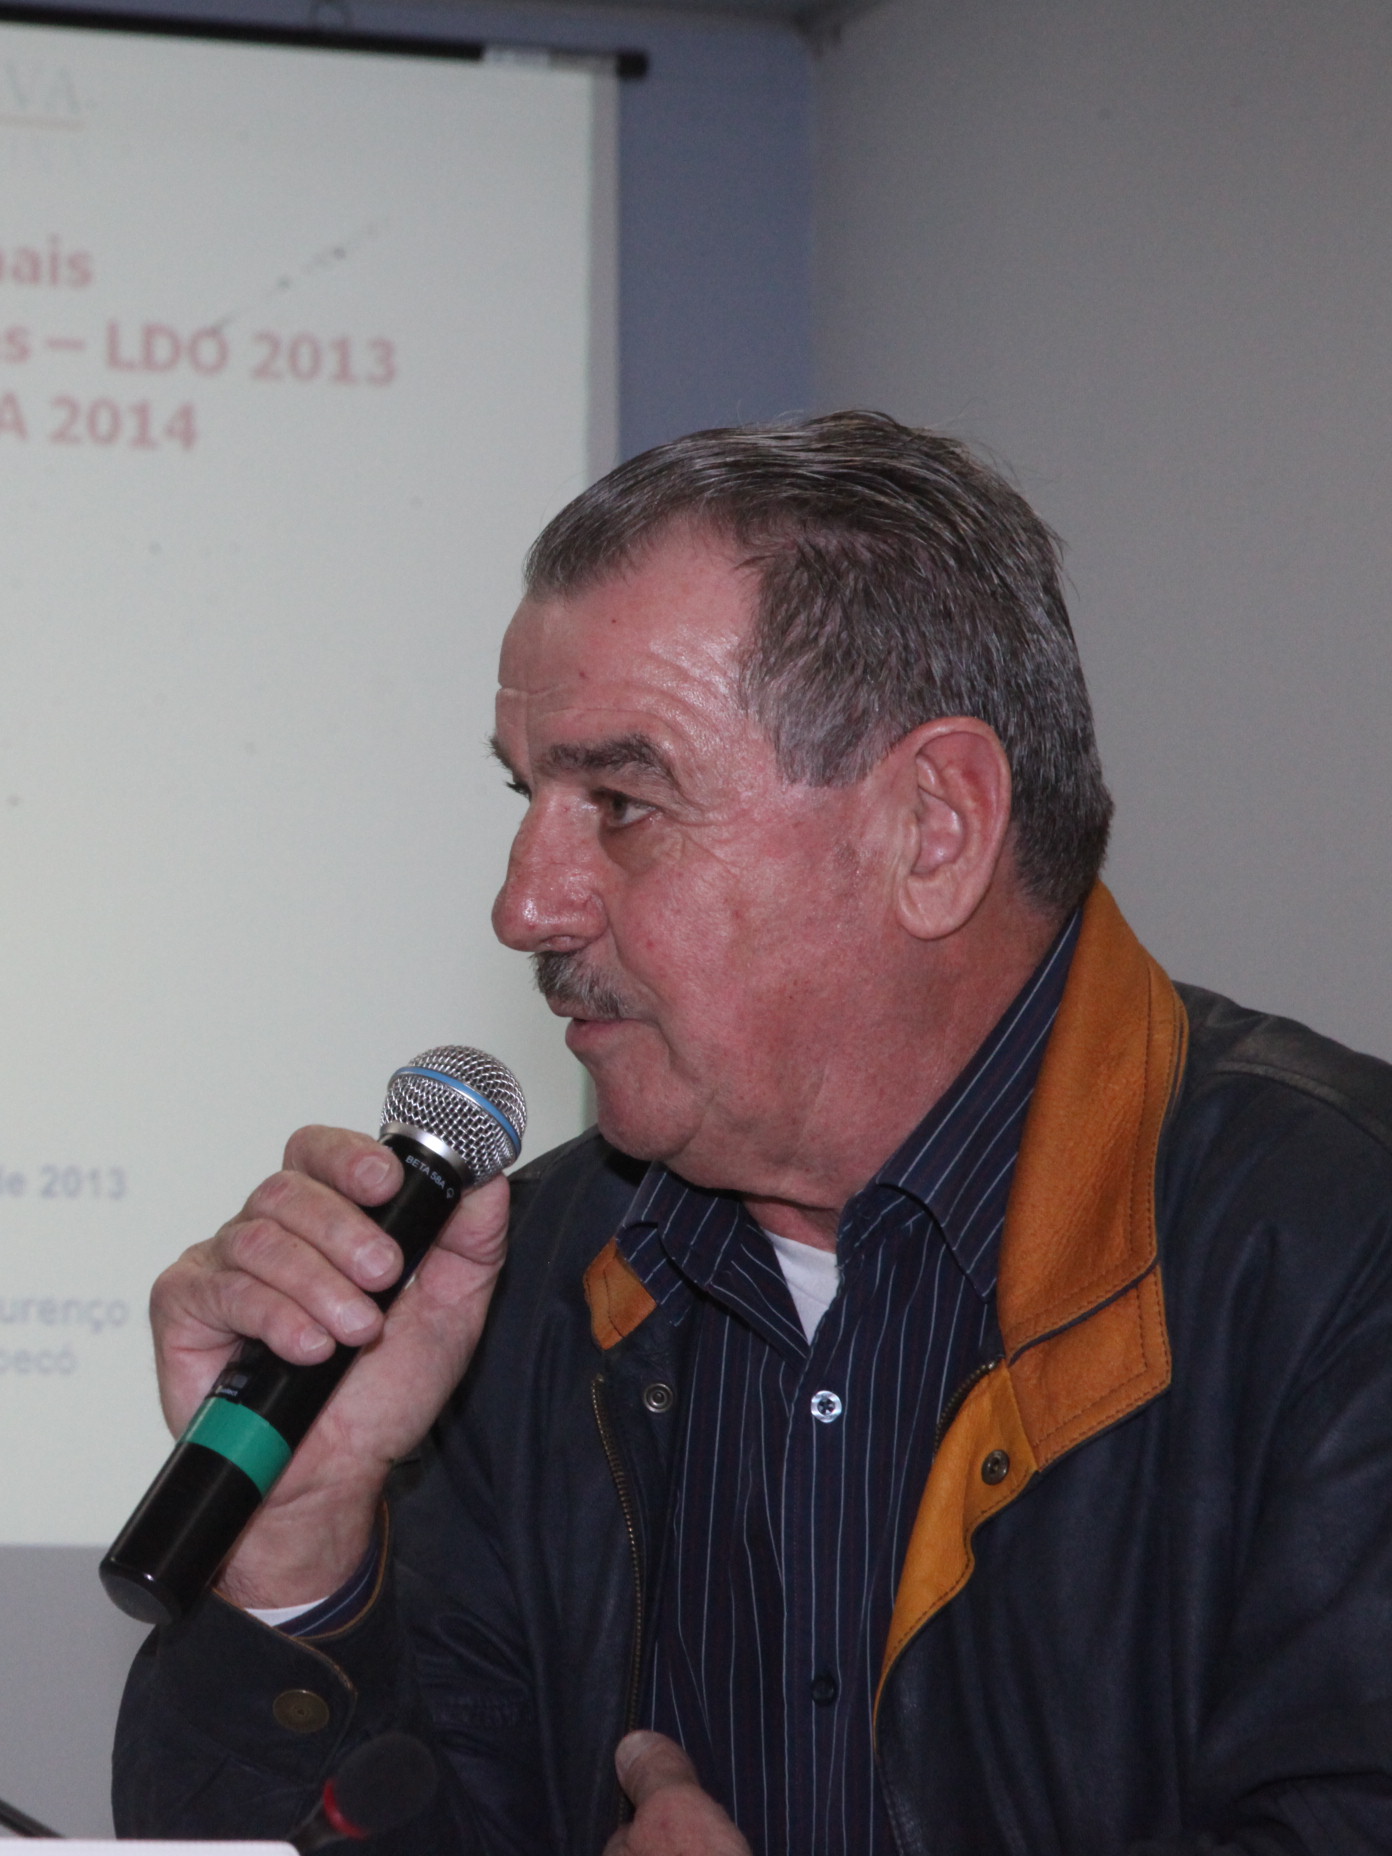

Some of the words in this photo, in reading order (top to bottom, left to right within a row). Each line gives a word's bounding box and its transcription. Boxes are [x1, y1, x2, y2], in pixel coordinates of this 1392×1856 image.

[106, 320, 230, 376] LDO
[251, 330, 398, 387] 2013
[49, 396, 198, 452] 2014
[39, 1165, 128, 1202] 2013
[405, 1155, 430, 1176] BETA
